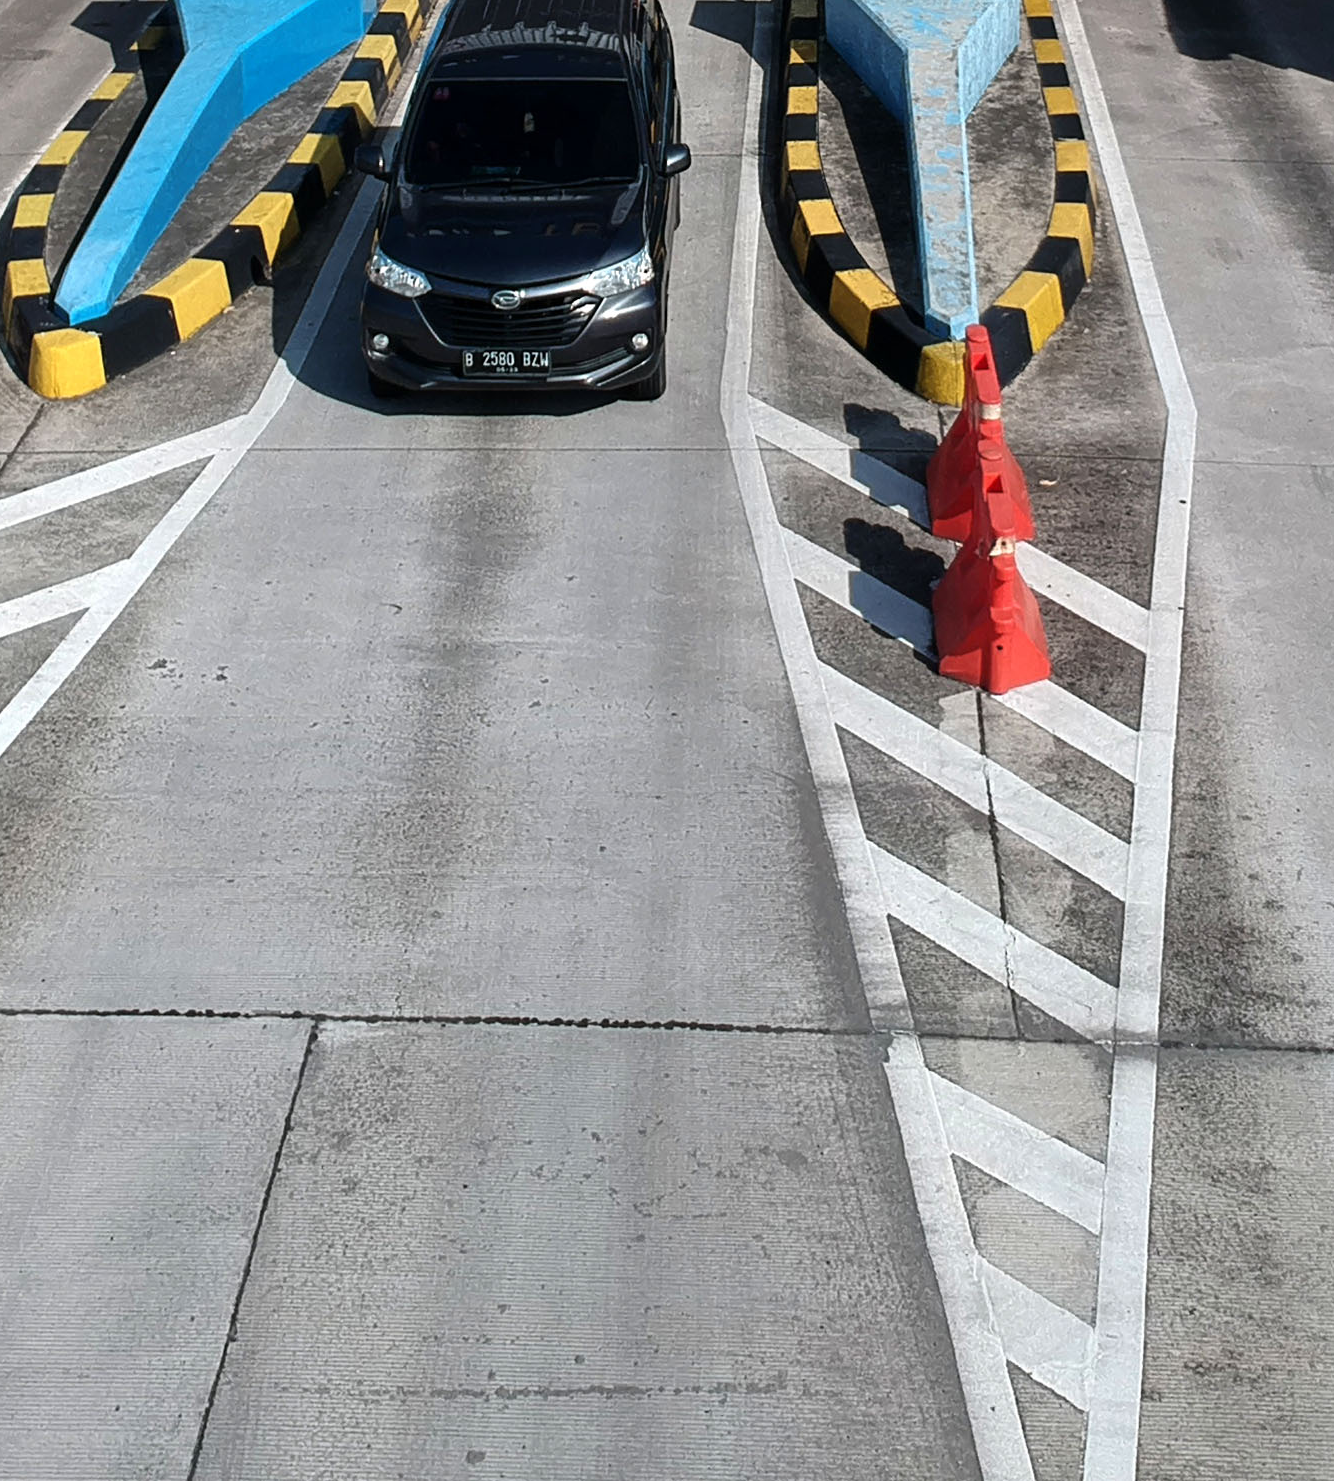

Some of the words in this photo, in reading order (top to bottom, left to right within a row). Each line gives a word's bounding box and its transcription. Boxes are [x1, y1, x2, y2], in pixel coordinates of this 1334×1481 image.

[465, 352, 474, 367] B
[482, 351, 515, 366] 2580
[523, 351, 549, 368] BZW
